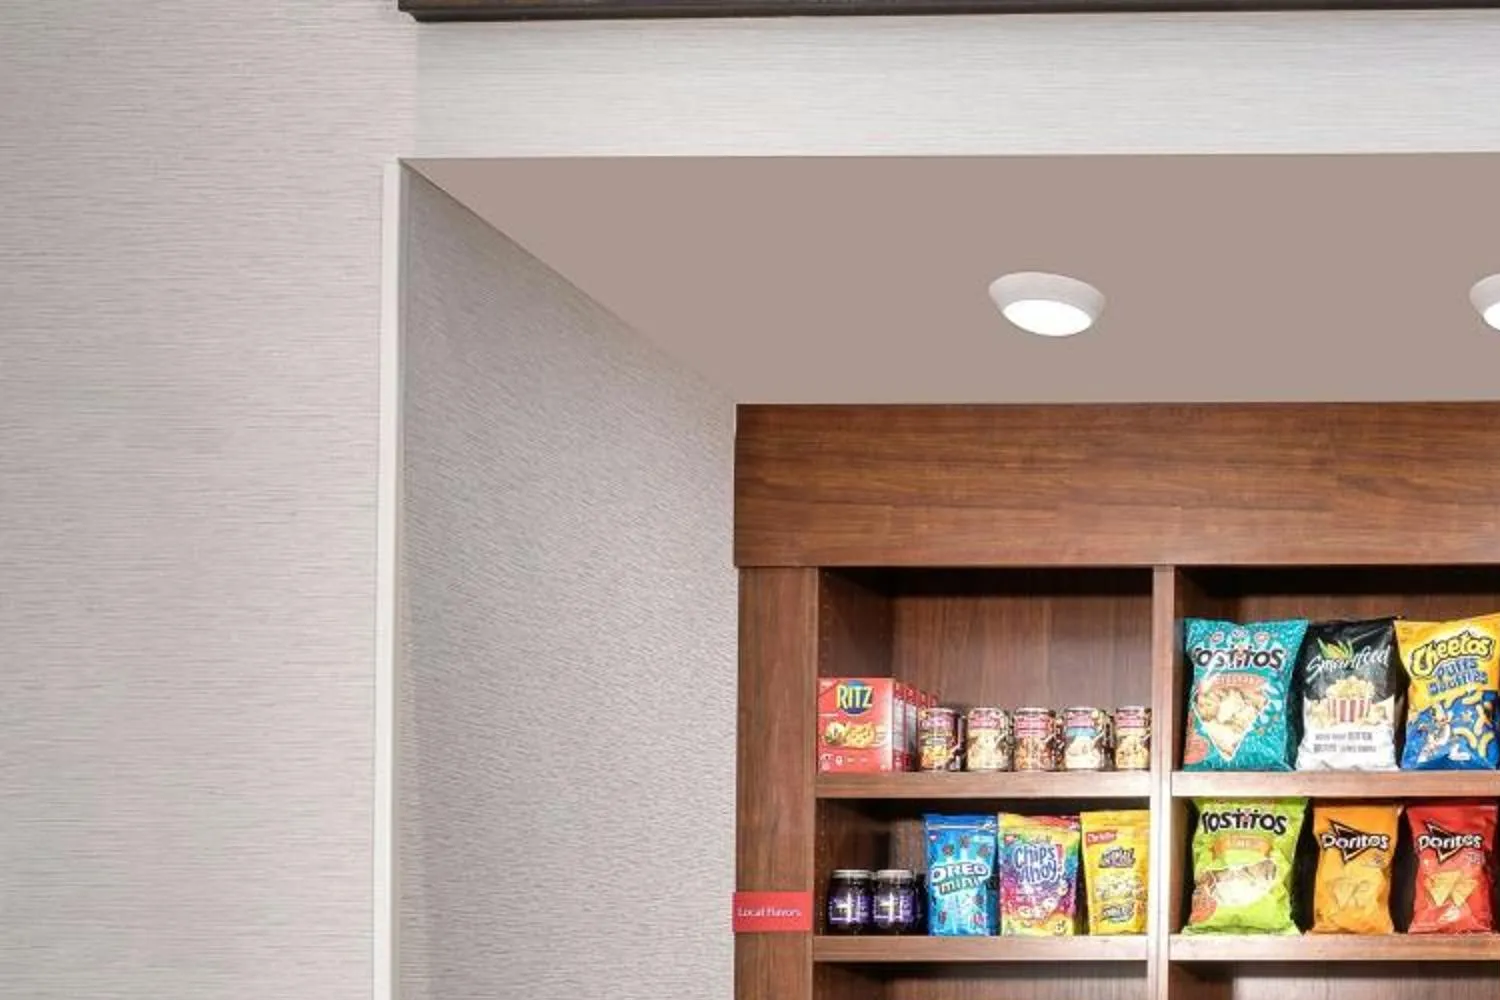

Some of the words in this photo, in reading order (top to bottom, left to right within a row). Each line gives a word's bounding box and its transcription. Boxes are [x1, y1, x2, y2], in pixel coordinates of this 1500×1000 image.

[1410, 630, 1496, 680] Cheetos
[836, 683, 875, 710] RITZ
[1320, 832, 1391, 851] Doritos
[1416, 832, 1484, 851] Doritos
[930, 861, 990, 883] OREO
[736, 907, 765, 918] Local
